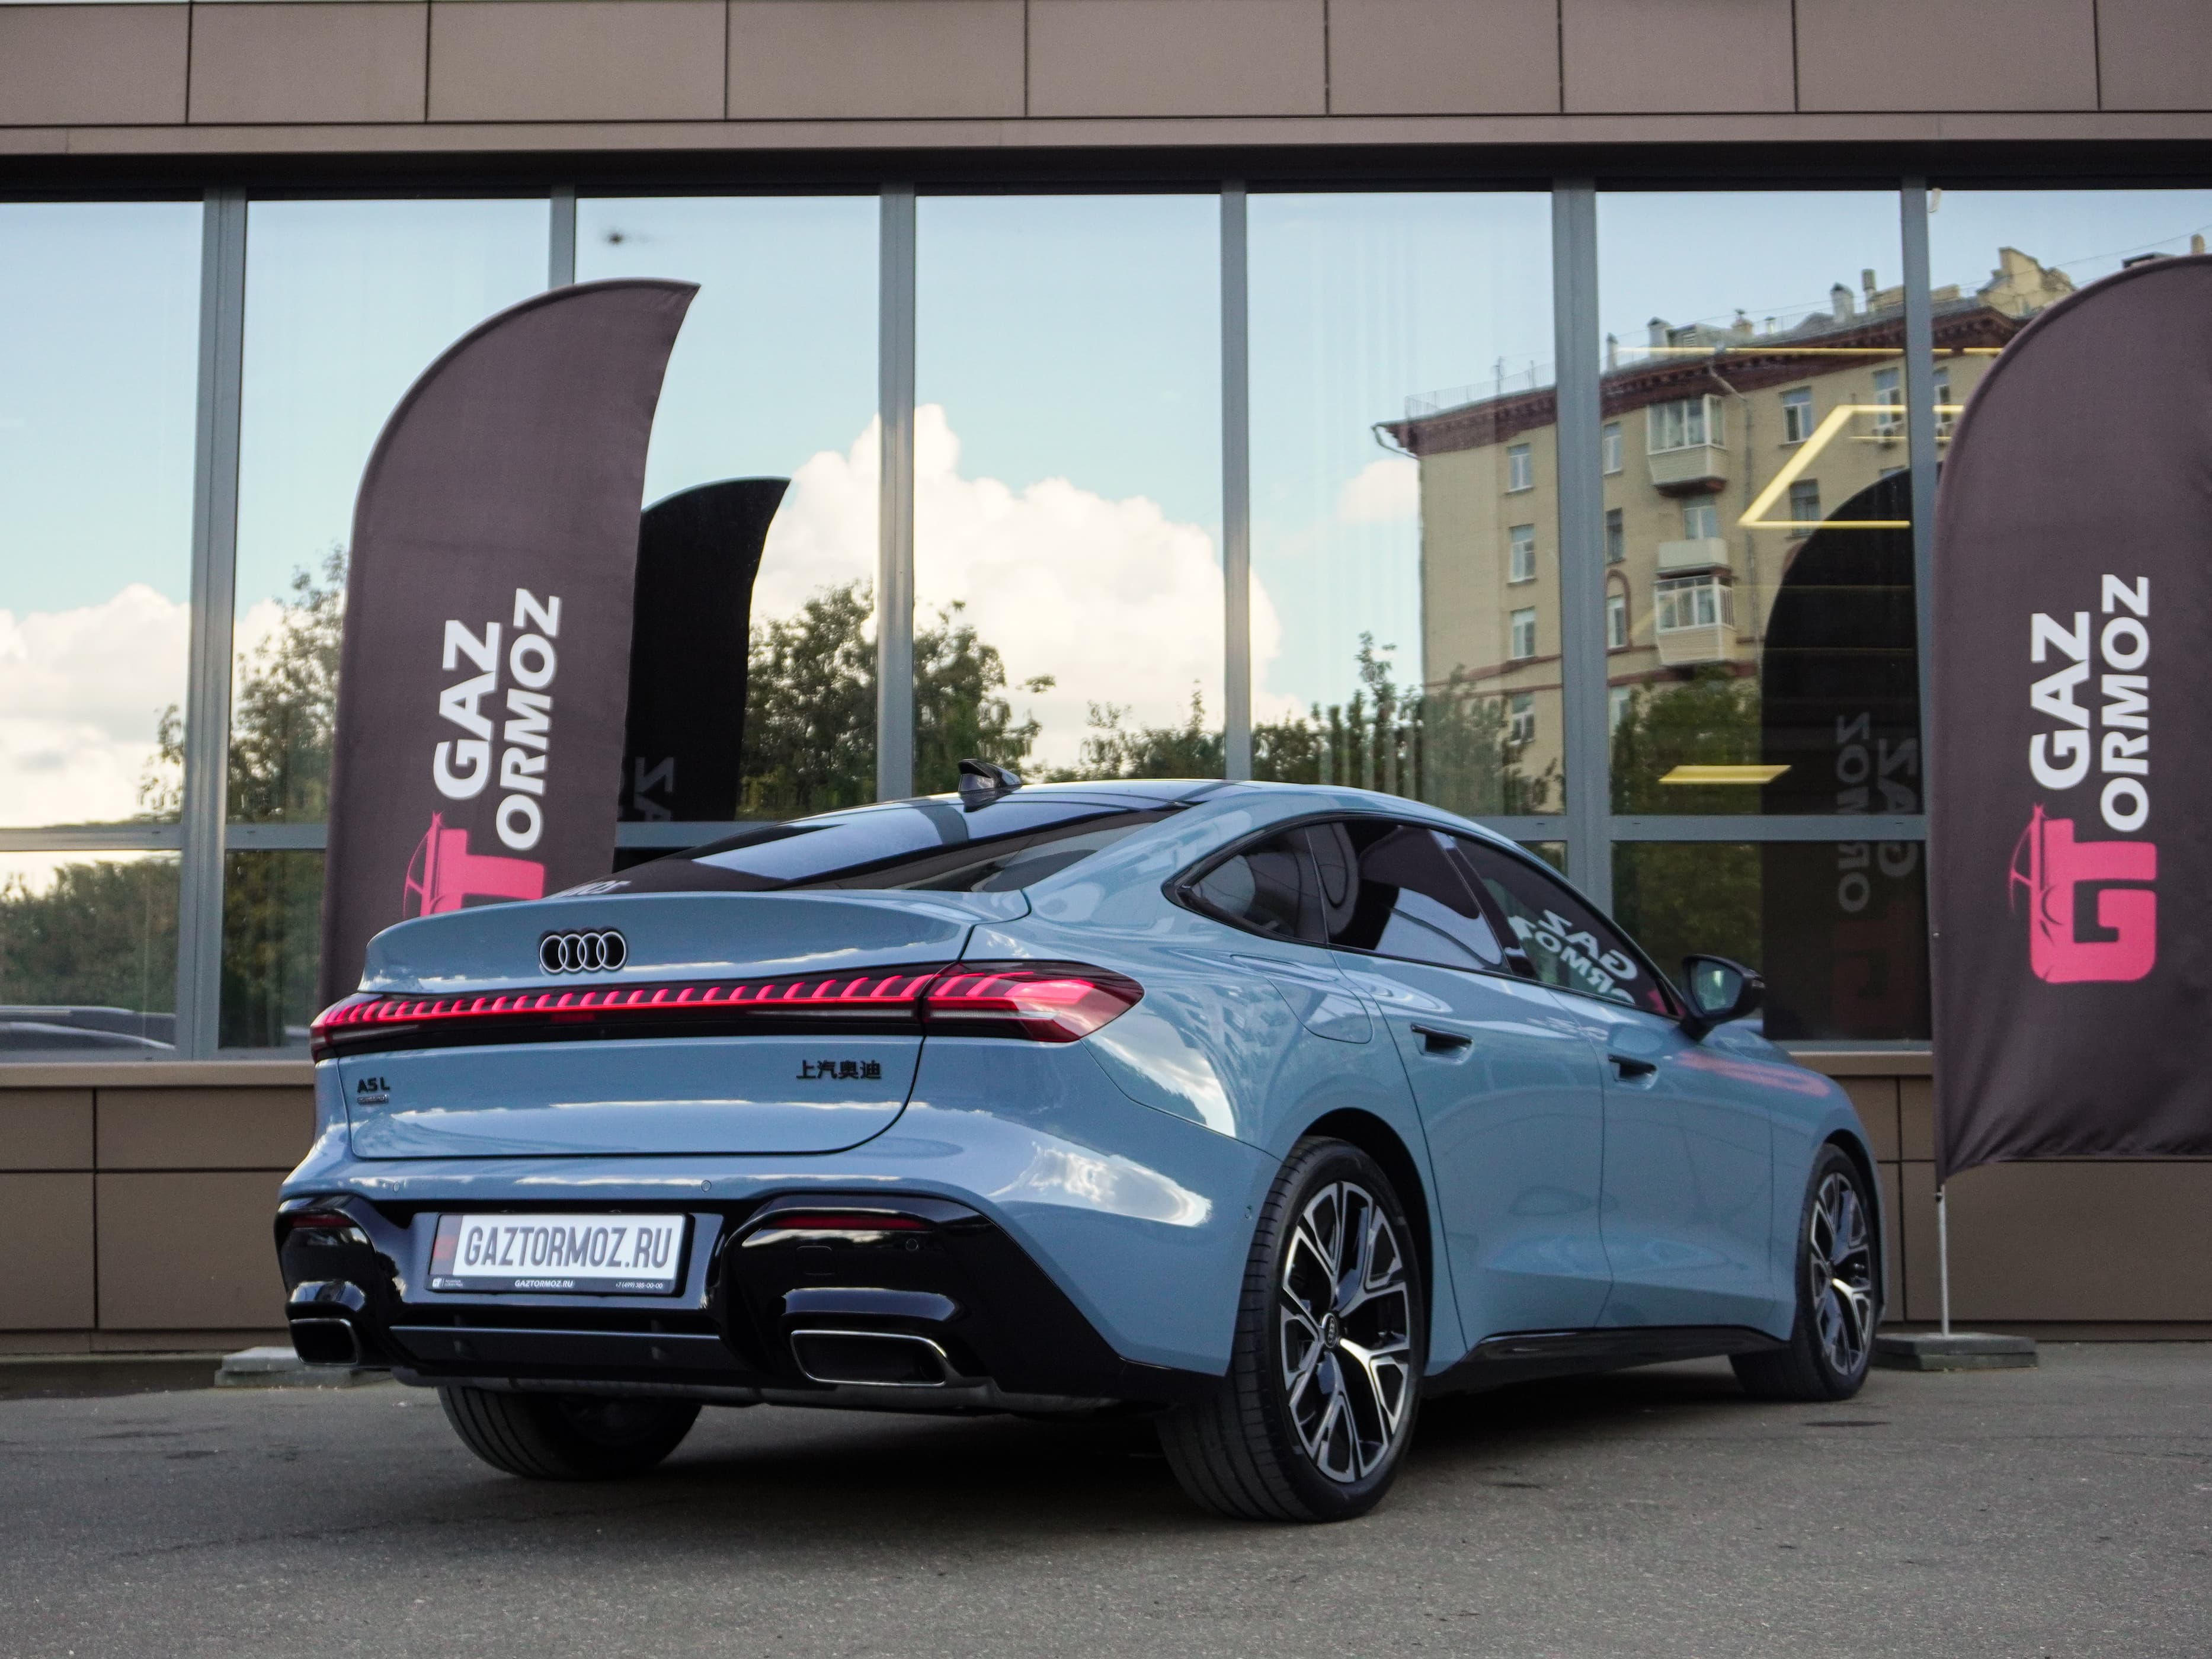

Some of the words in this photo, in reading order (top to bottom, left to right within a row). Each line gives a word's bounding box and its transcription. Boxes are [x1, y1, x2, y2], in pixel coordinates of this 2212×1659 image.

[433, 620, 502, 800] GAZ
[495, 588, 561, 850] ORMOZ
[2029, 611, 2091, 790] GAZ
[2101, 574, 2149, 832] ORMOZ
[796, 1059, 882, 1080] 上汽奥迪
[463, 1225, 673, 1269] GAZTORMOZ.RU
[514, 1279, 574, 1289] GAZTORMOZ.RU
